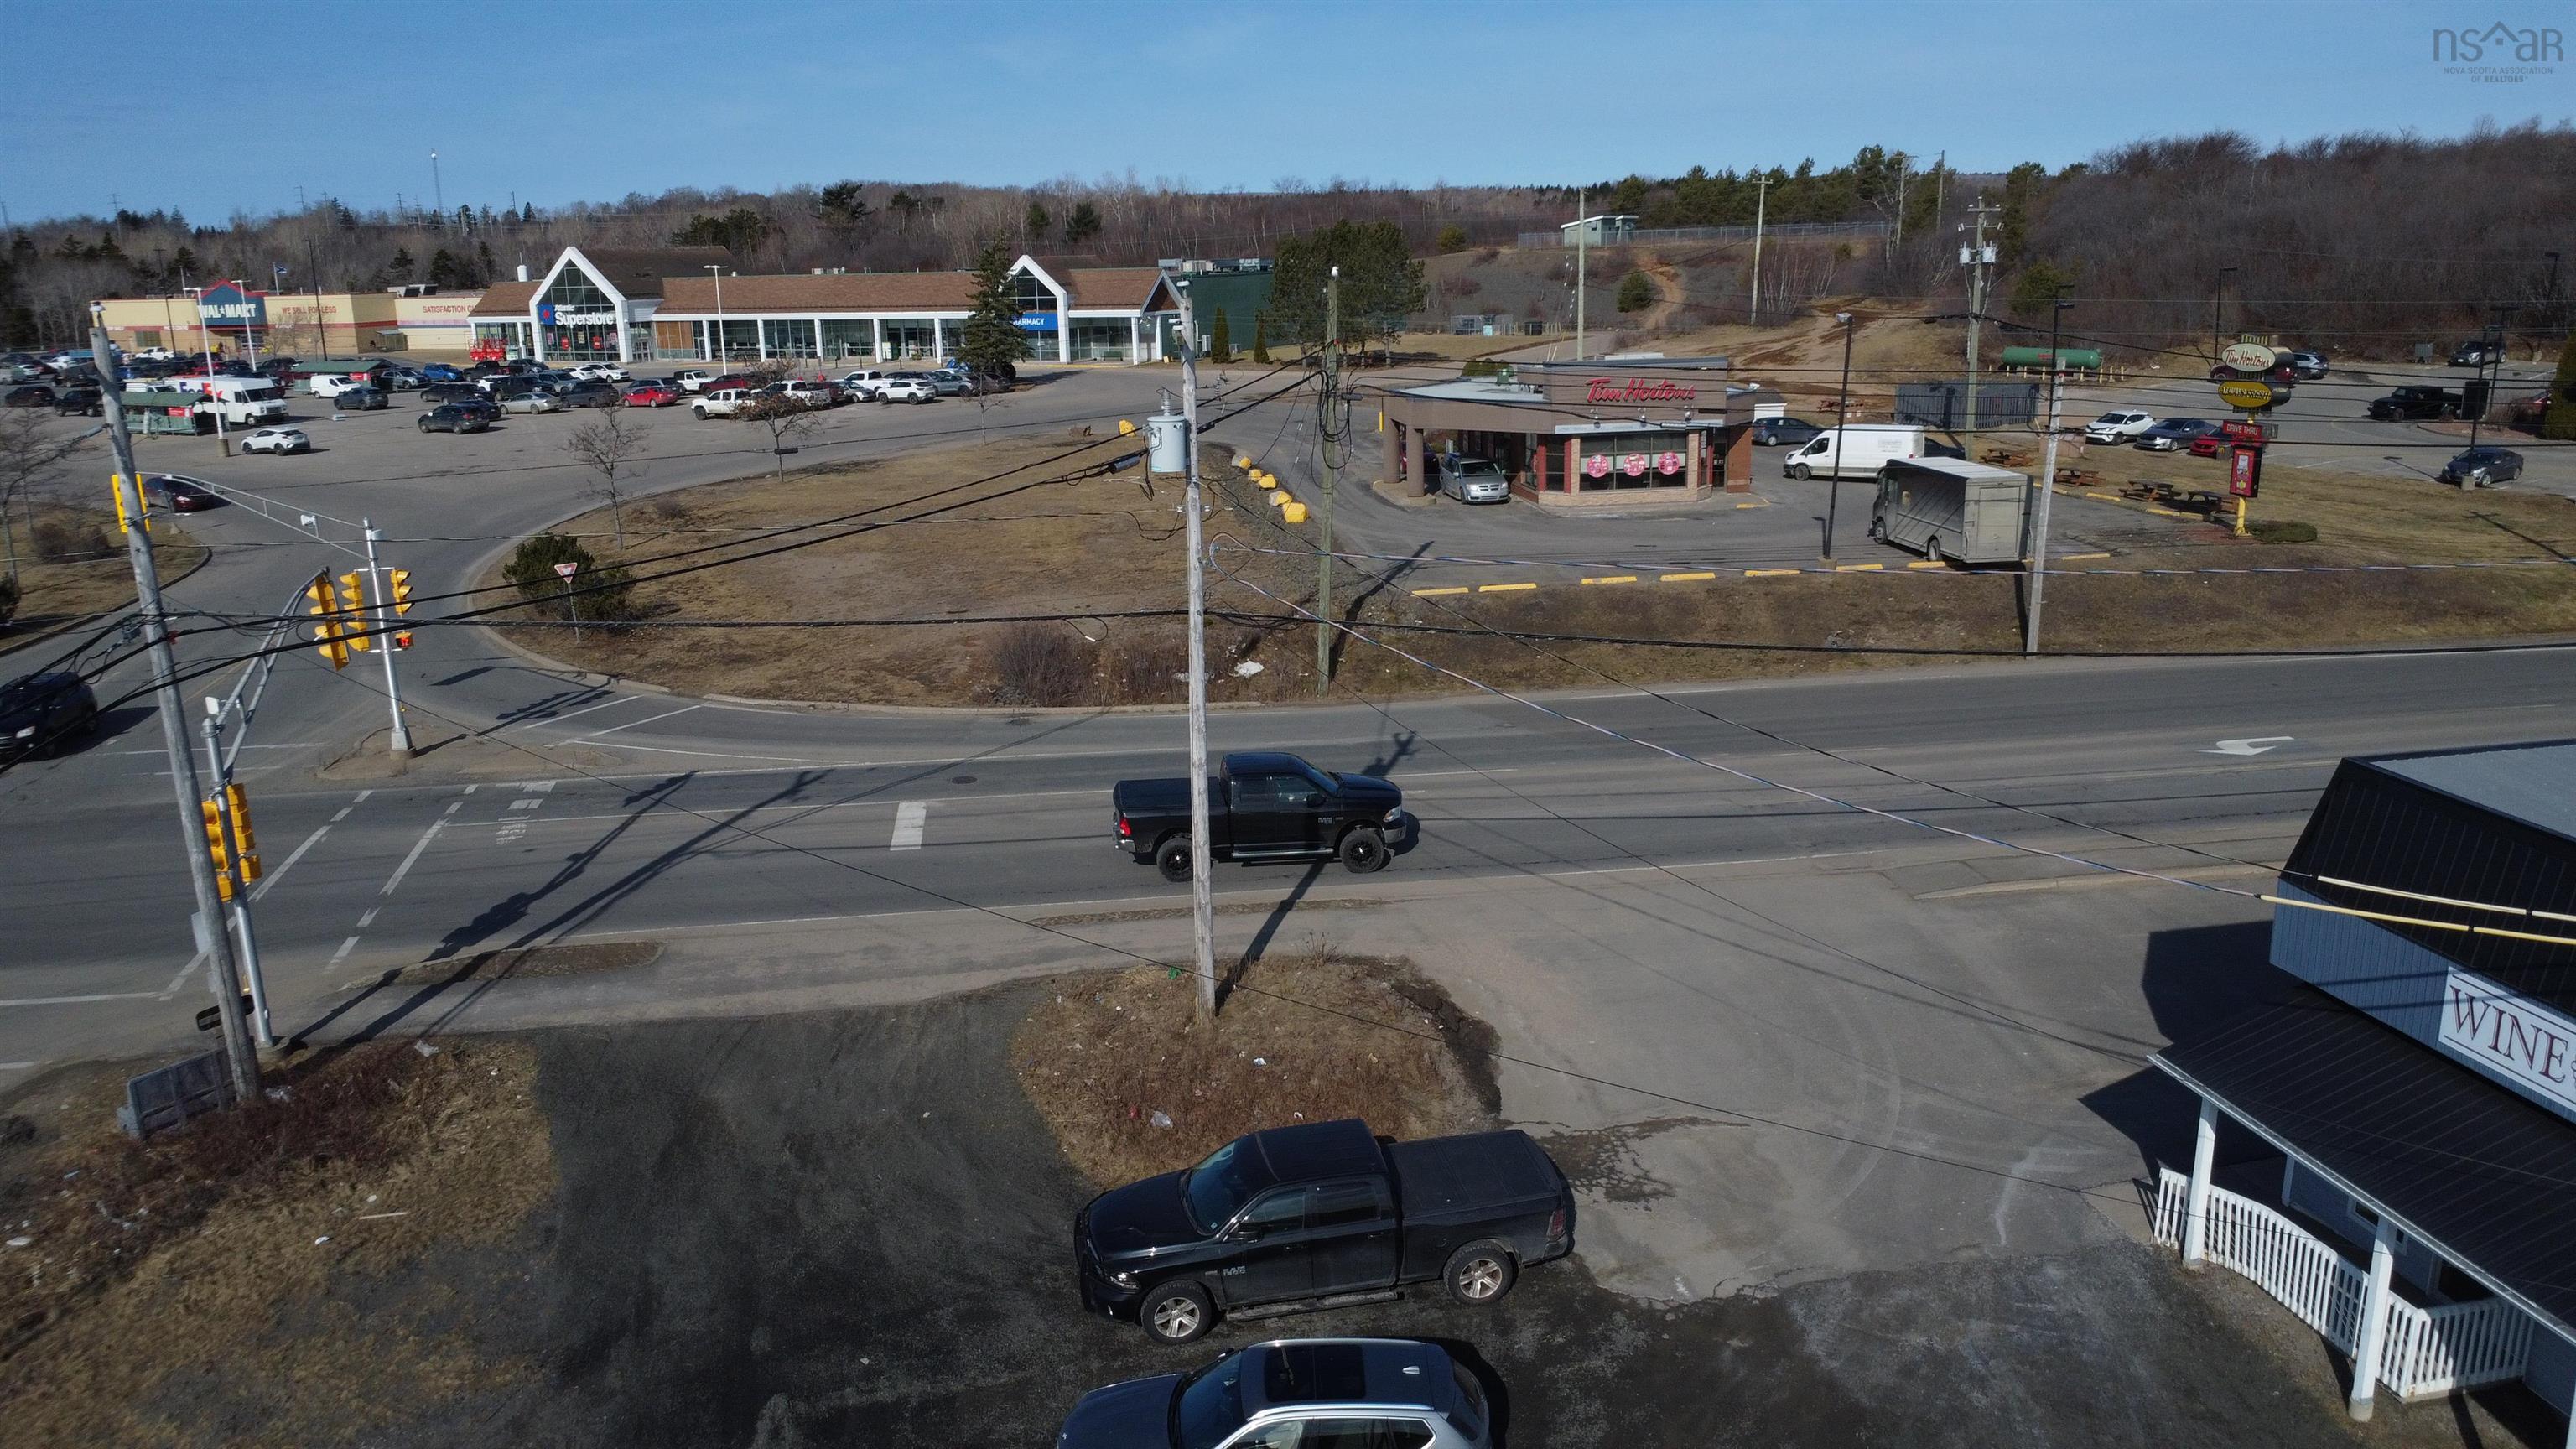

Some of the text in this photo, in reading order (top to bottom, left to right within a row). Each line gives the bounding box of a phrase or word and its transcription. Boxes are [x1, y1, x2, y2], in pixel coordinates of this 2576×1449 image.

[282, 306, 290, 314] WE
[321, 305, 337, 314] LESS
[423, 304, 466, 314] SATISFACTION
[554, 312, 614, 328] Superstore
[2225, 349, 2272, 368] Tim Hortons
[1585, 377, 1697, 403] Tim Hortons
[2226, 423, 2258, 435] DRIVE THRU
[2449, 985, 2568, 1083] WINE
